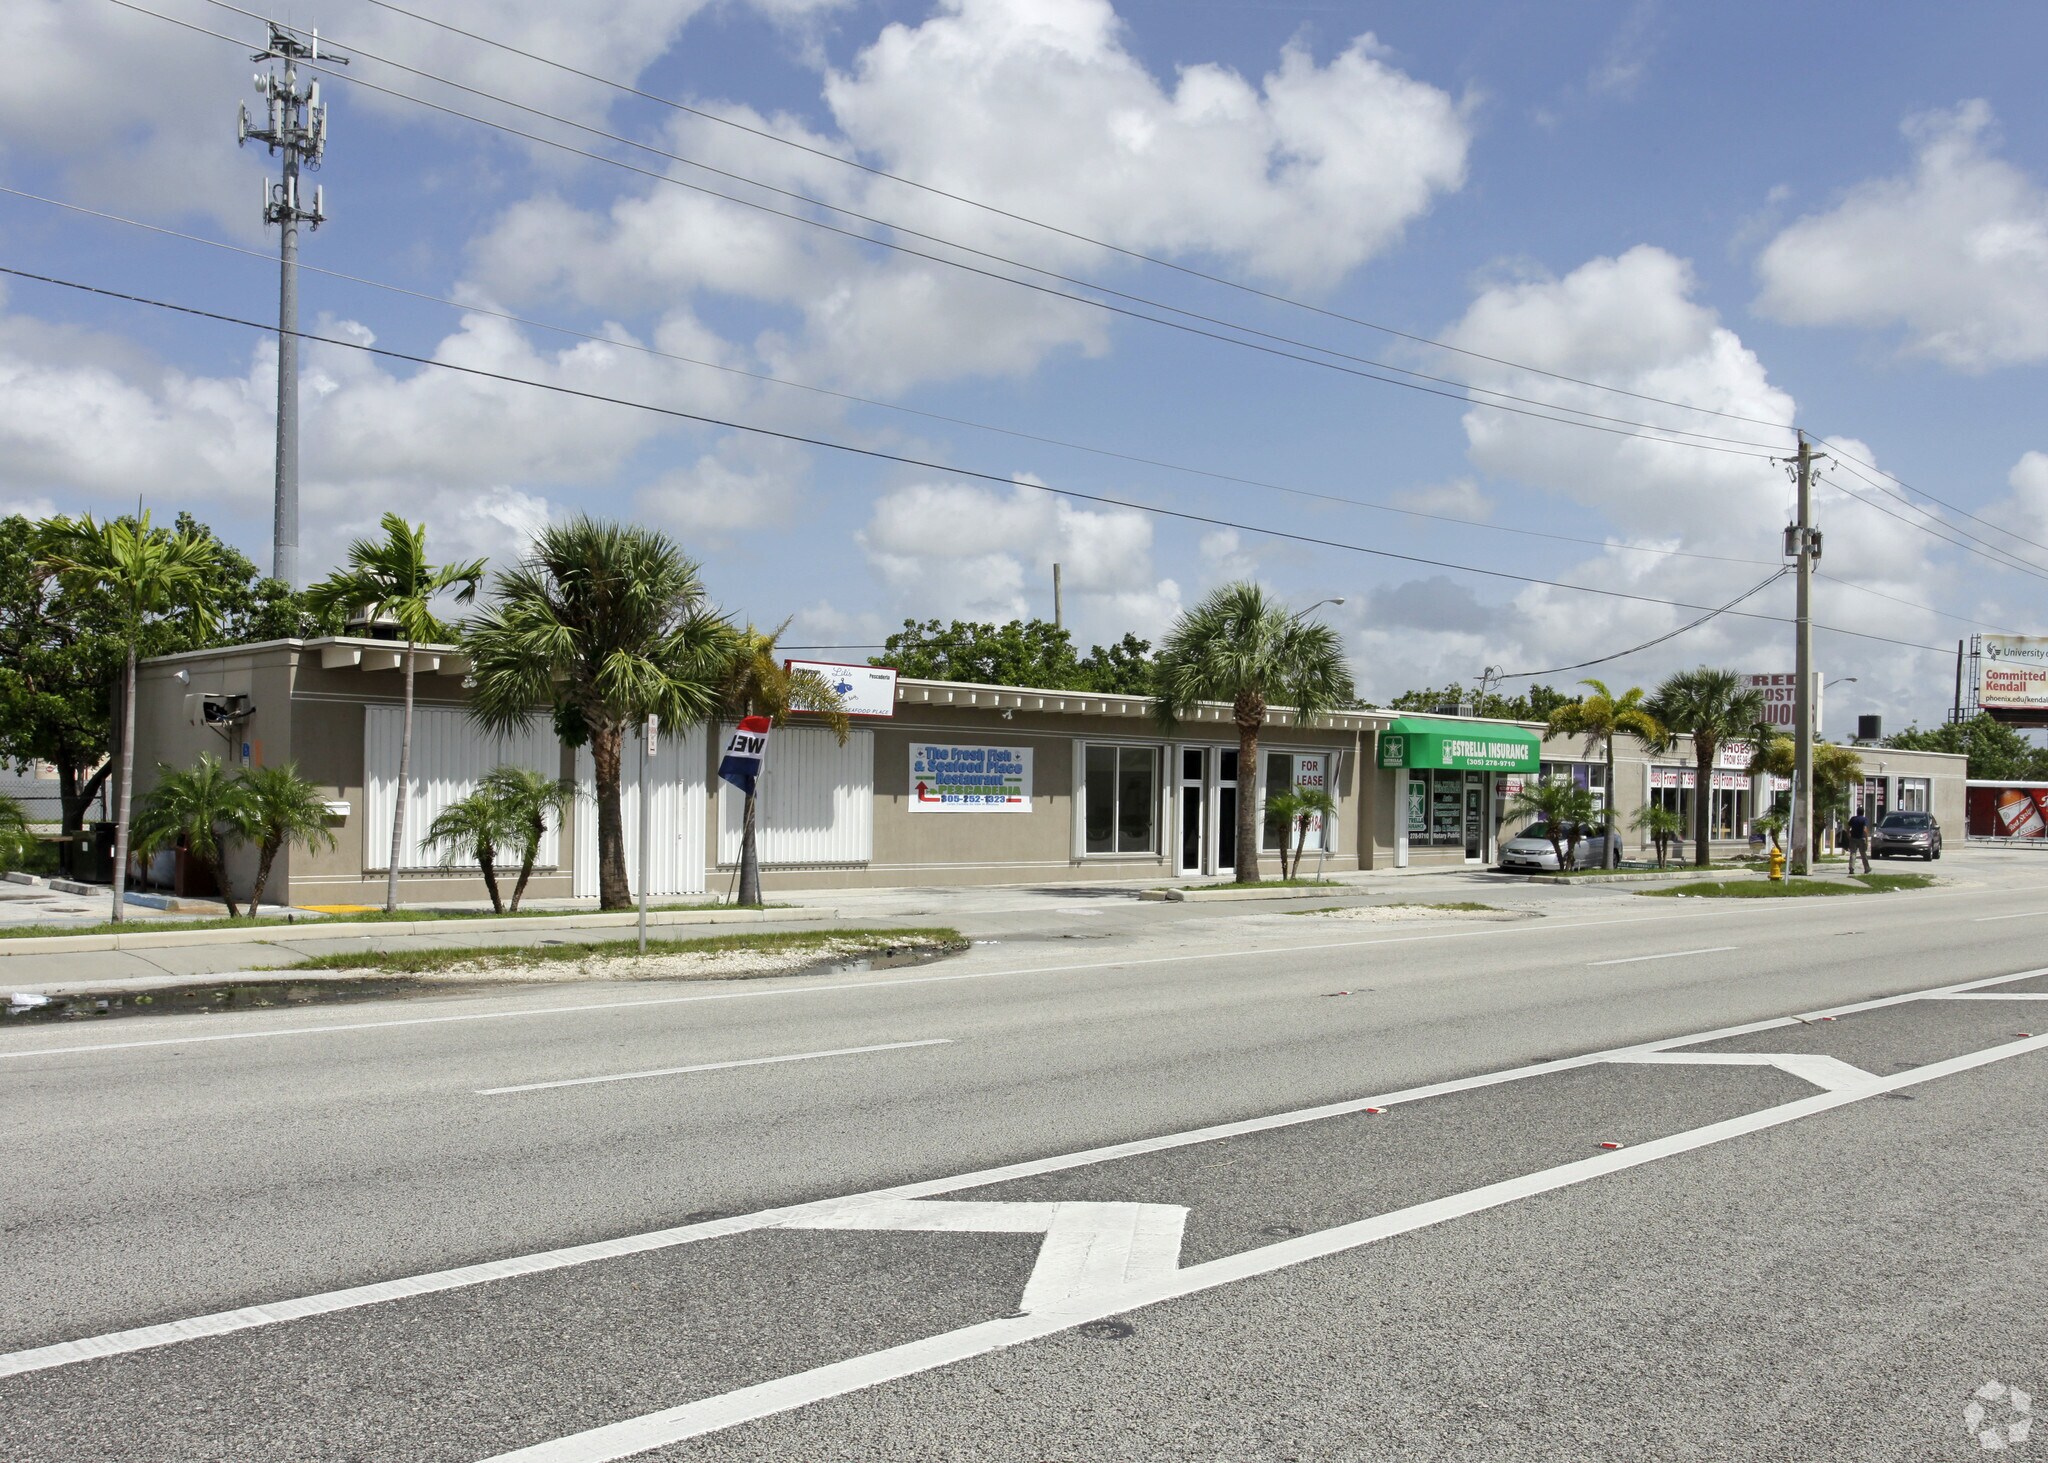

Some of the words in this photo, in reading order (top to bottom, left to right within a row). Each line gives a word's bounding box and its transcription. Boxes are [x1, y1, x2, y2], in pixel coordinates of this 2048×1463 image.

[2004, 648, 2045, 659] University
[1986, 669, 2046, 681] Committed
[1986, 681, 2026, 692] Kendall
[925, 746, 949, 760] The
[951, 747, 985, 761] Fresh
[987, 748, 1012, 762] Fish
[1452, 740, 1487, 758] ESTRELLA
[1488, 742, 1529, 760] INSURANCE
[1722, 743, 1749, 754] SHOES
[1724, 755, 1736, 764] FROM
[914, 760, 925, 772] &
[927, 760, 984, 773] Seafood
[986, 762, 1023, 774] Place
[1301, 760, 1318, 771] FOR
[935, 772, 1003, 785] Restaurant
[1297, 775, 1323, 786] LEASE
[1664, 771, 1677, 785] From
[1722, 772, 1733, 786] From
[938, 786, 1021, 795] PESCADERIA
[941, 794, 1006, 803] 305-252-1323
